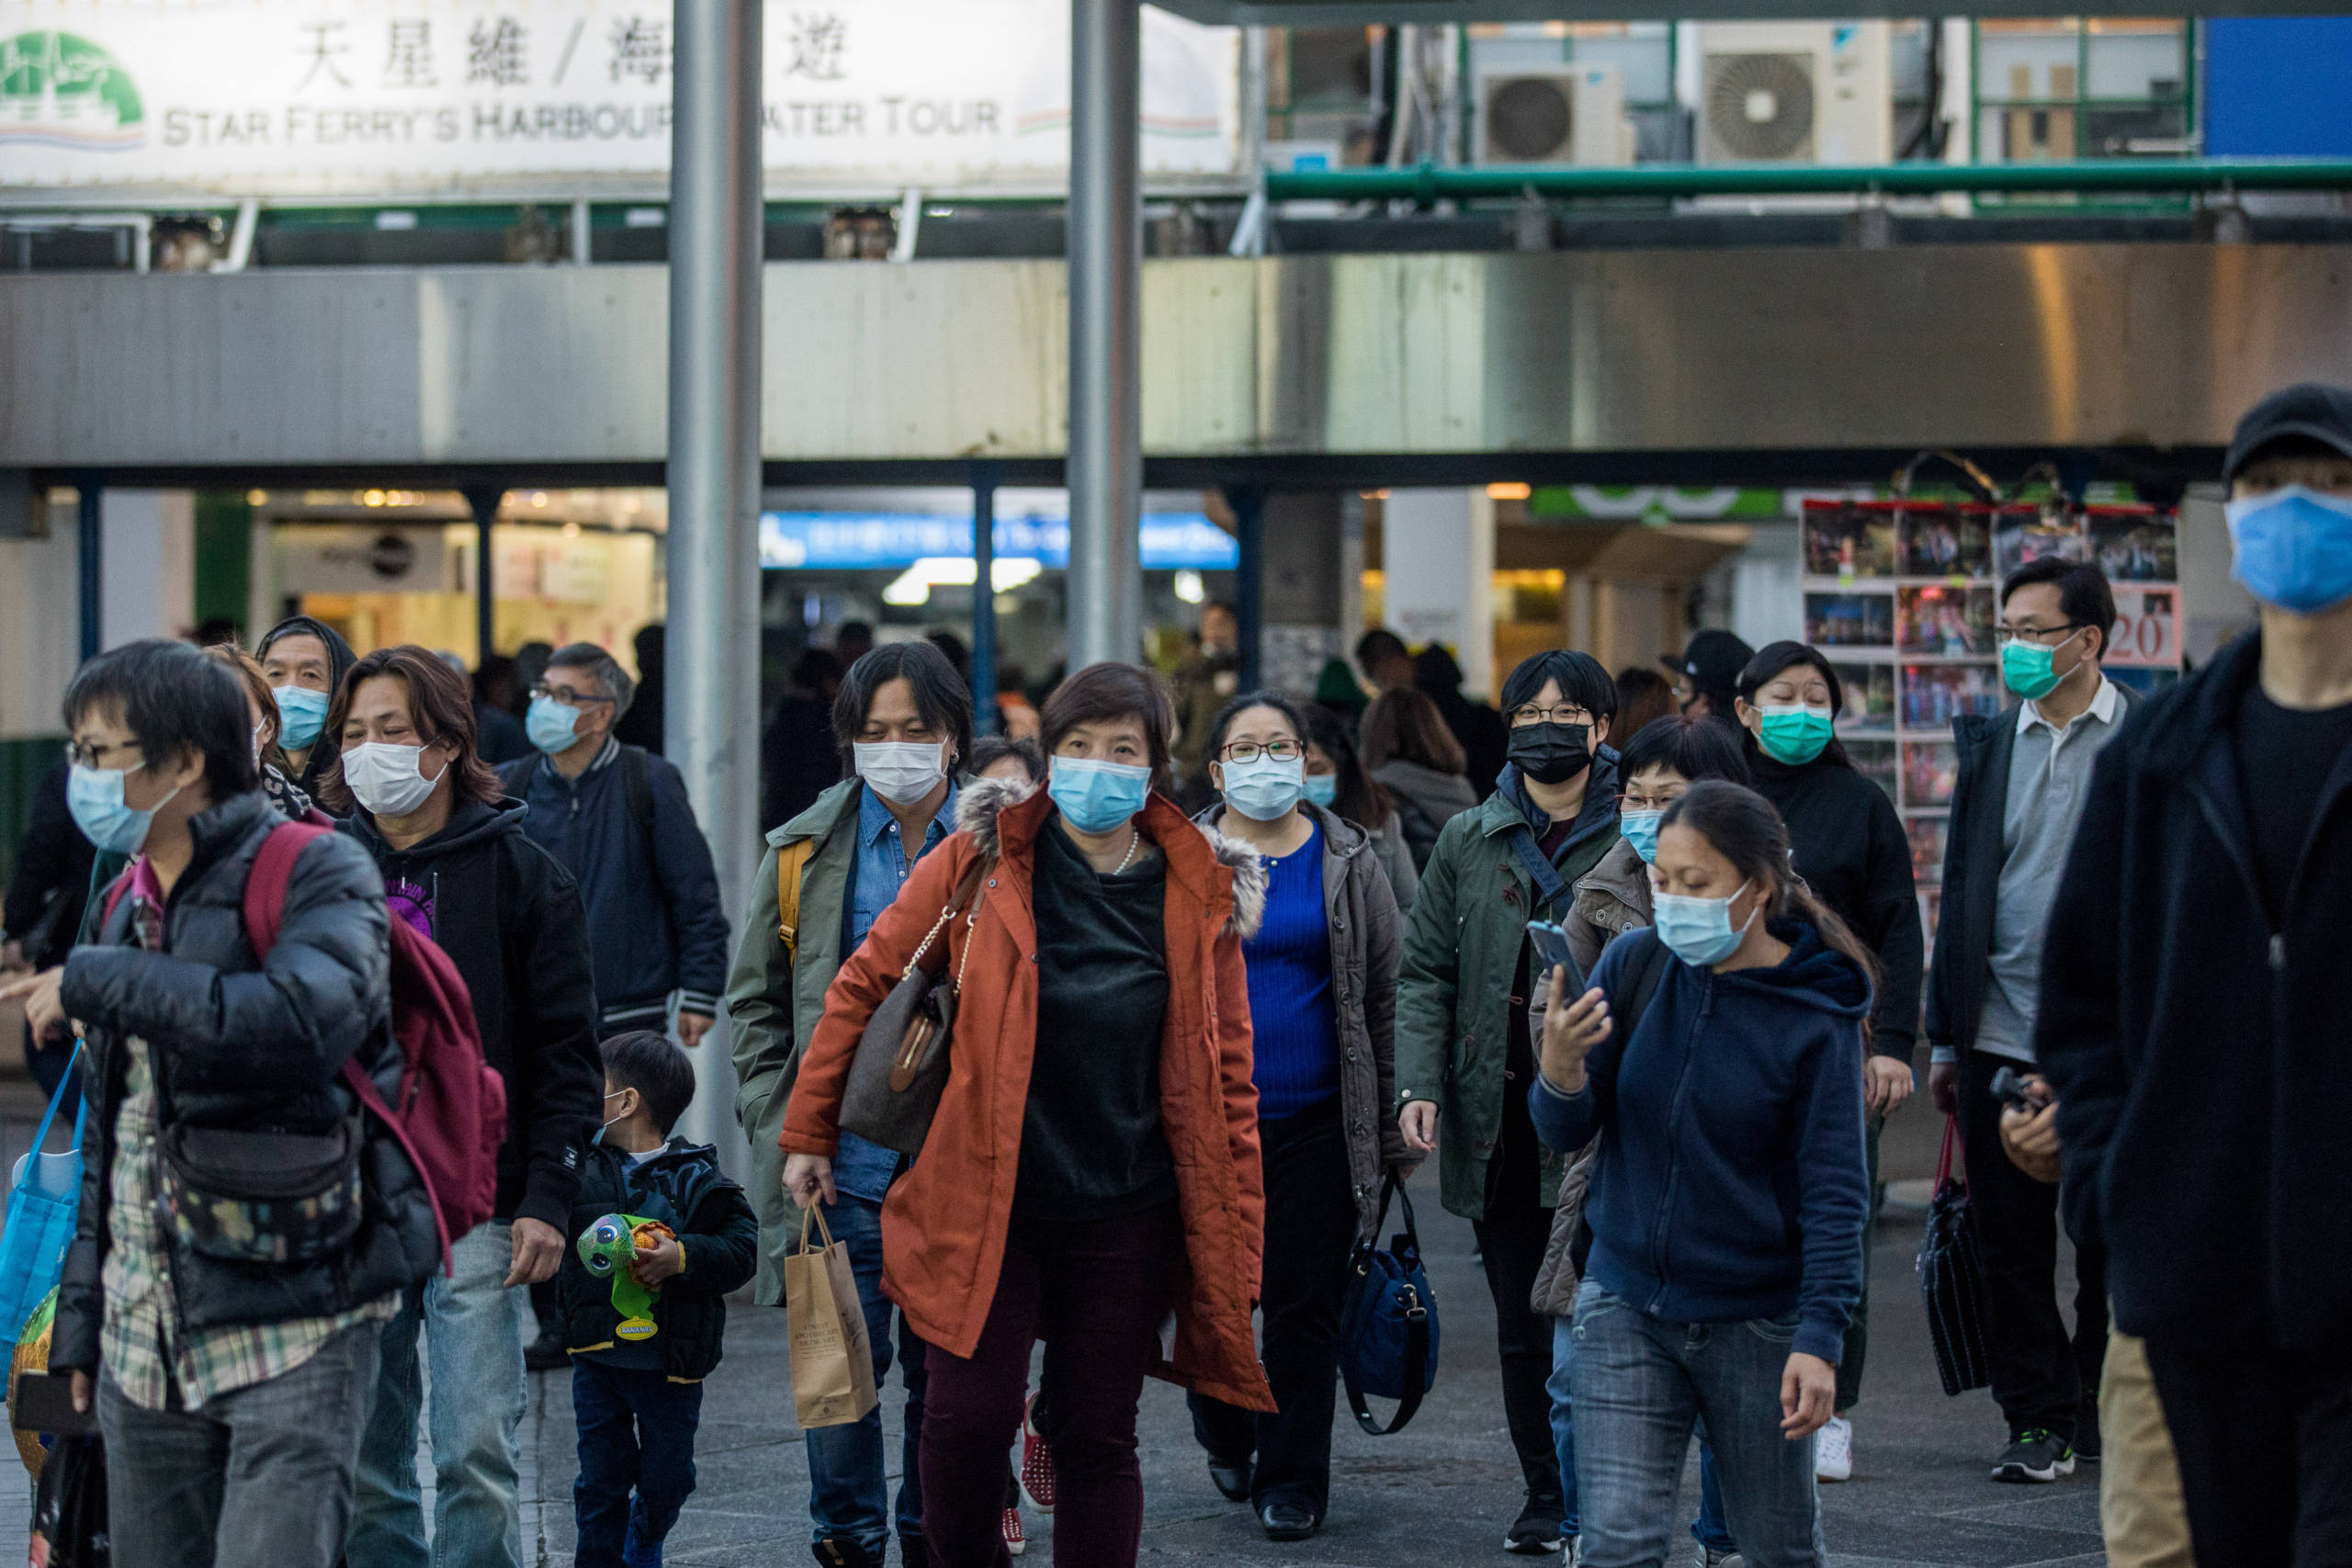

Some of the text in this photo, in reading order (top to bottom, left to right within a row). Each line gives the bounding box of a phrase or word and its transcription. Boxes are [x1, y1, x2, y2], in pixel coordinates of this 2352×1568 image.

[163, 106, 269, 144] STAR
[285, 104, 459, 143] FERRY'S
[763, 100, 868, 137] ATER
[881, 94, 1001, 136] TOUR
